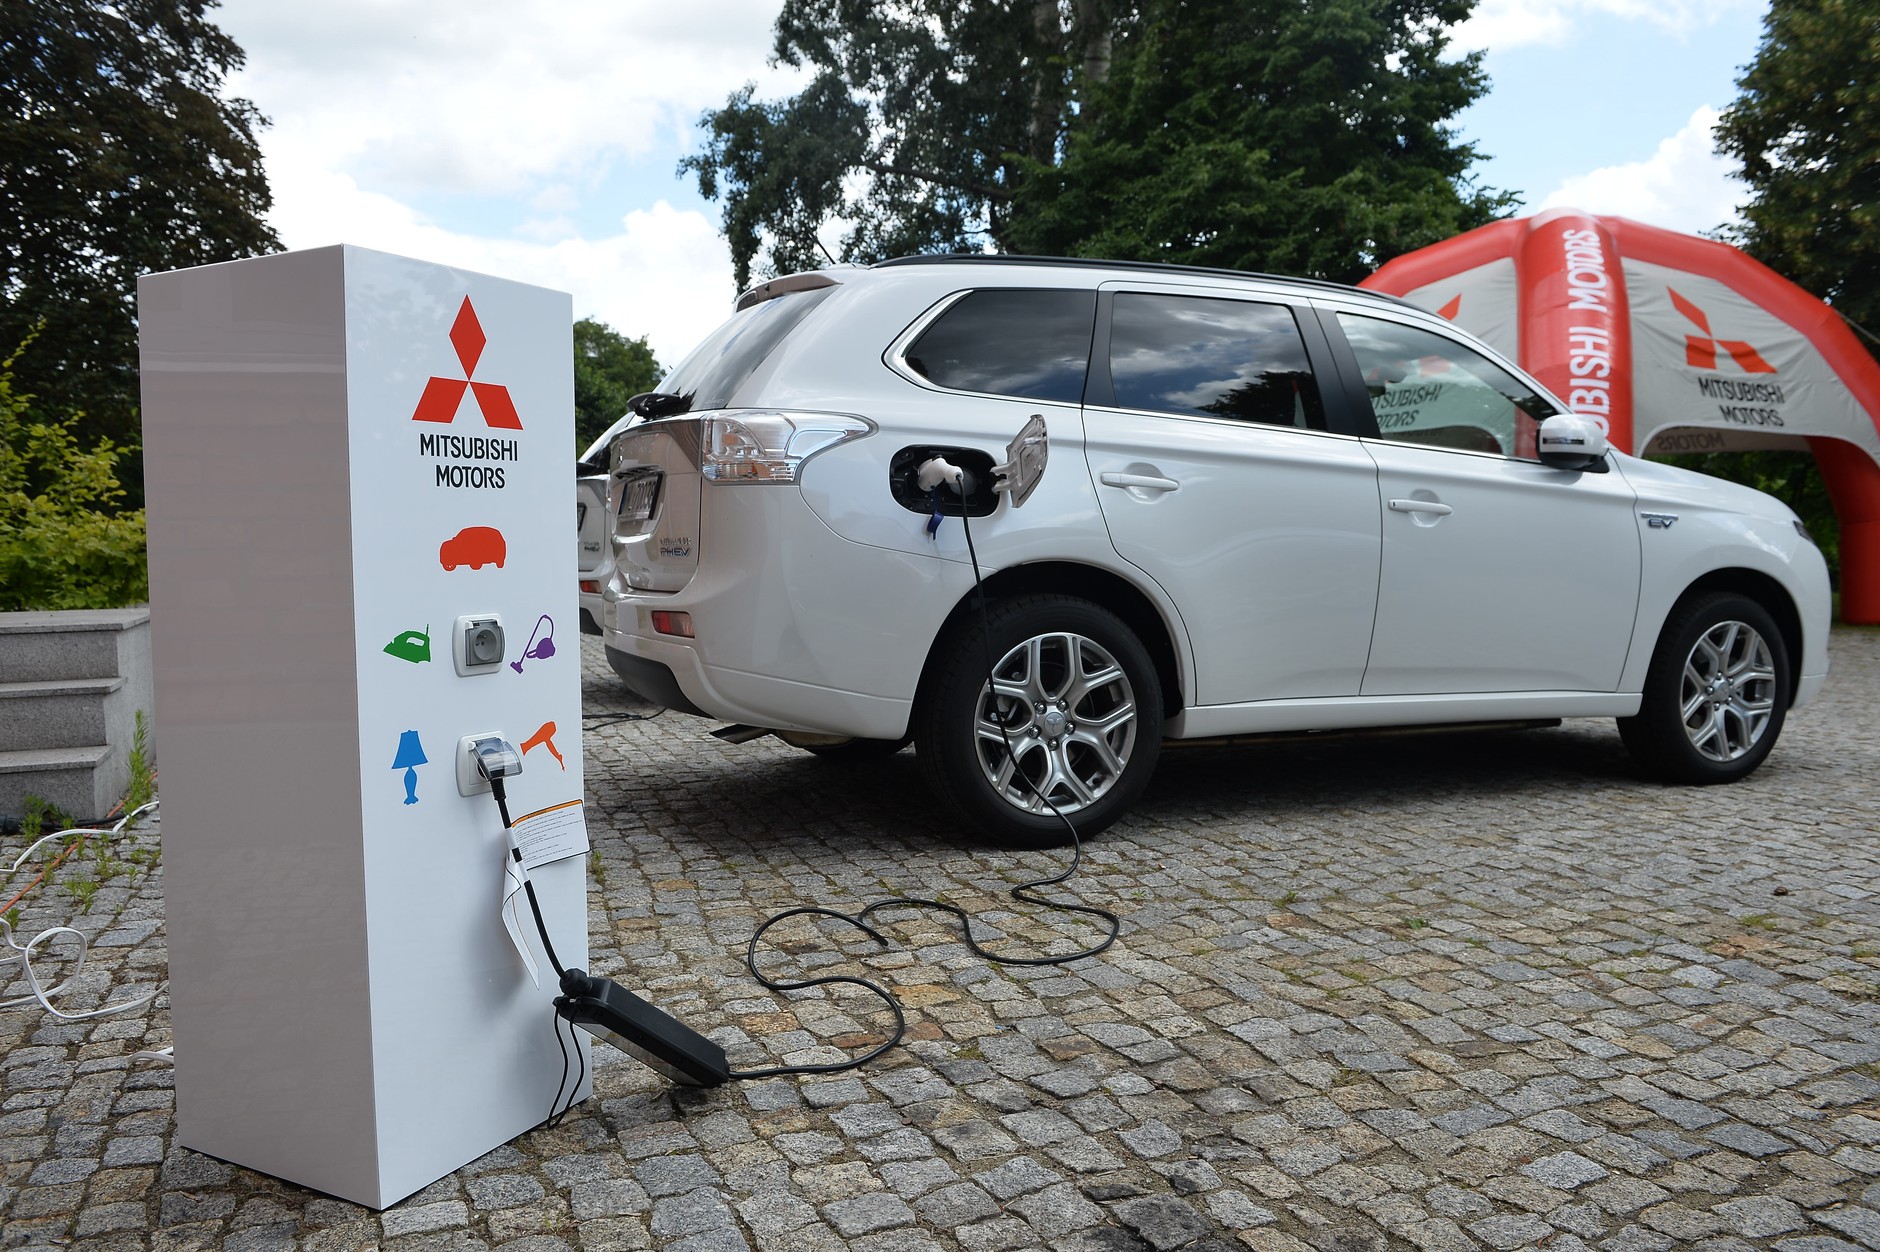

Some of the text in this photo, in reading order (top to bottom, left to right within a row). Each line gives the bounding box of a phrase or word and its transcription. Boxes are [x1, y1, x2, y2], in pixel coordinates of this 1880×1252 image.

[1562, 228, 1608, 313] MOTORS
[1698, 376, 1786, 404] MITSUBISHI
[1376, 409, 1420, 429] OTORS
[1718, 404, 1785, 427] MOTORS
[420, 433, 519, 462] MITSUBISHI
[436, 464, 506, 489] MOTORS
[660, 546, 691, 557] PHEV
